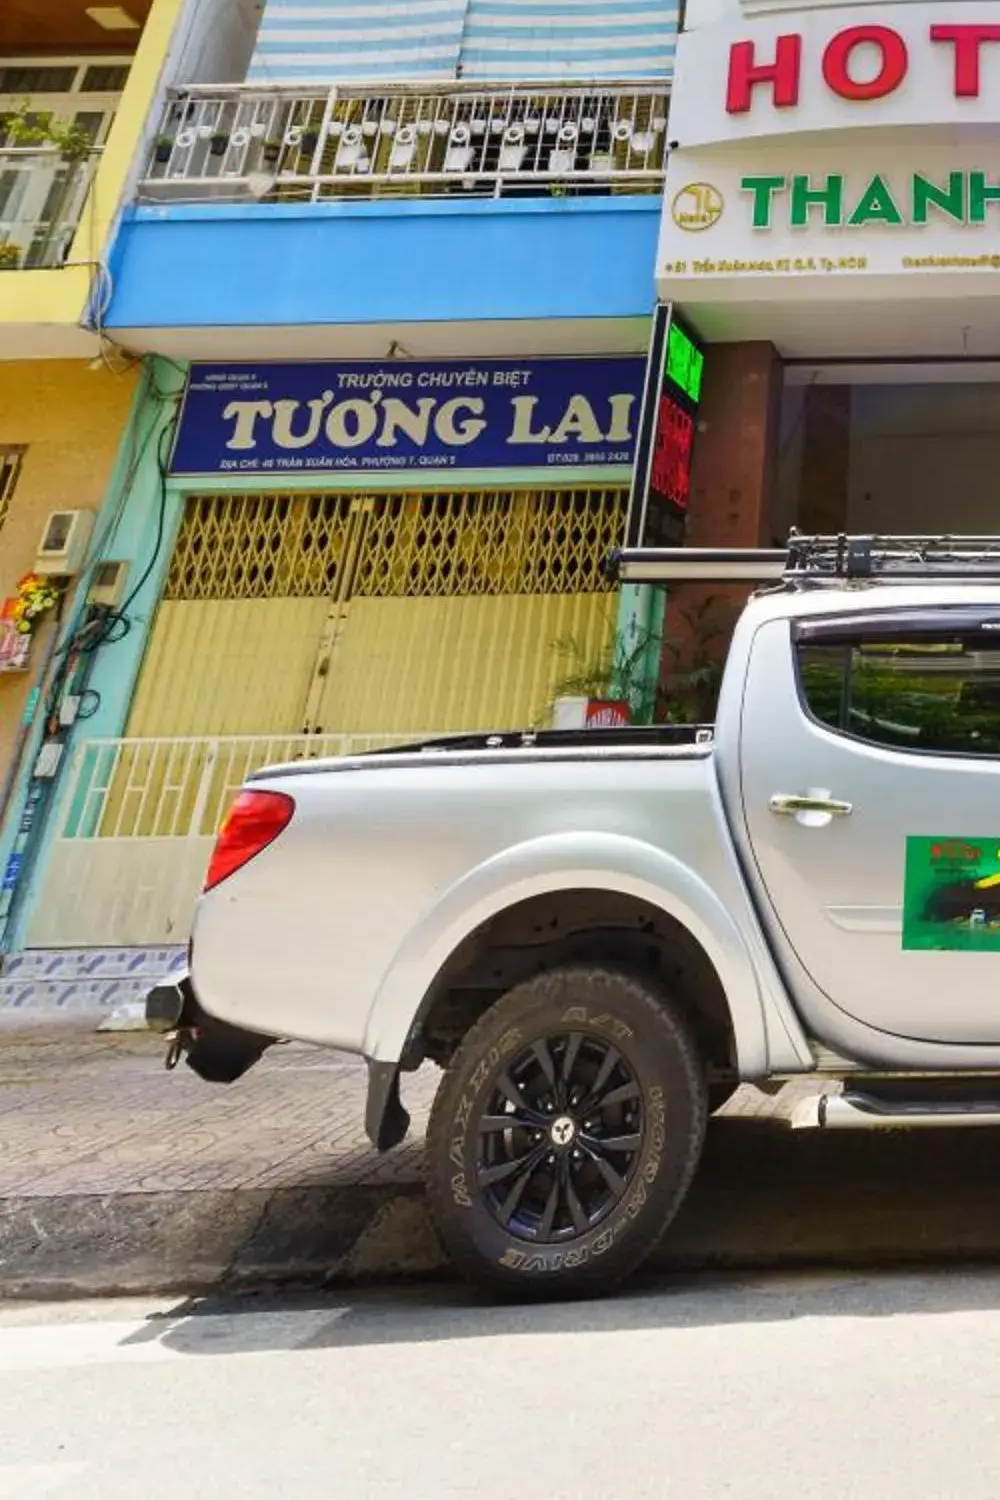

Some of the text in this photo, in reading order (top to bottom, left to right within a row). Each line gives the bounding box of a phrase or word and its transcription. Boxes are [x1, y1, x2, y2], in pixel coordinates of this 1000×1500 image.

[337, 368, 533, 389] TRƯỜNG CHUYÊN BIỆT
[222, 390, 636, 450] TƯƠNG LAI
